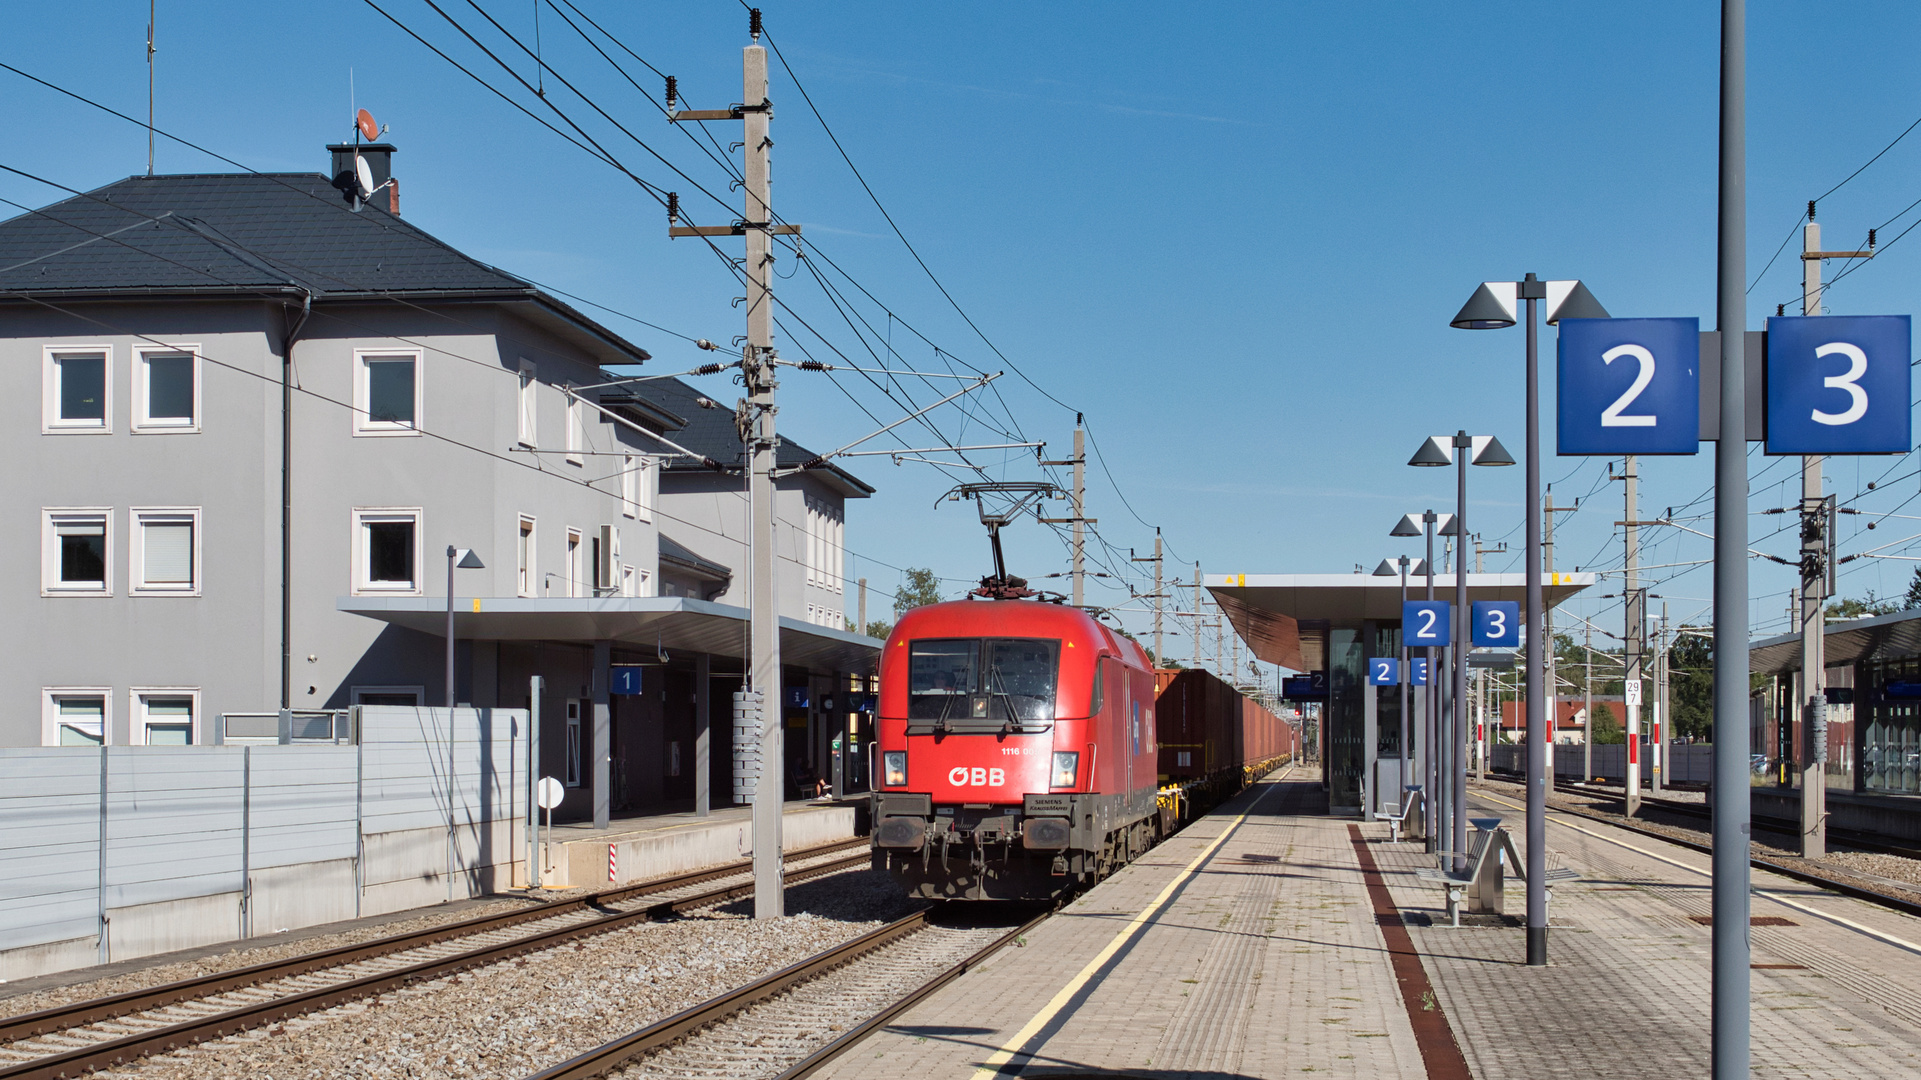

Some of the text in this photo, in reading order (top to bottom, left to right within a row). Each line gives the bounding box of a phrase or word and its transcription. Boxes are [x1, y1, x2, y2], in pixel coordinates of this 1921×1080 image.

[1601, 343, 1657, 427] 2
[1810, 341, 1869, 426] 3
[1416, 609, 1437, 638] 2
[1486, 609, 1506, 639] 3
[622, 671, 630, 690] 1
[1314, 673, 1324, 688] 2
[1377, 662, 1390, 681] 2
[1418, 662, 1427, 681] 3
[1627, 681, 1639, 692] 29
[1630, 693, 1636, 703] 7
[1001, 747, 1020, 756] 1116
[948, 766, 1006, 787] ÖBB
